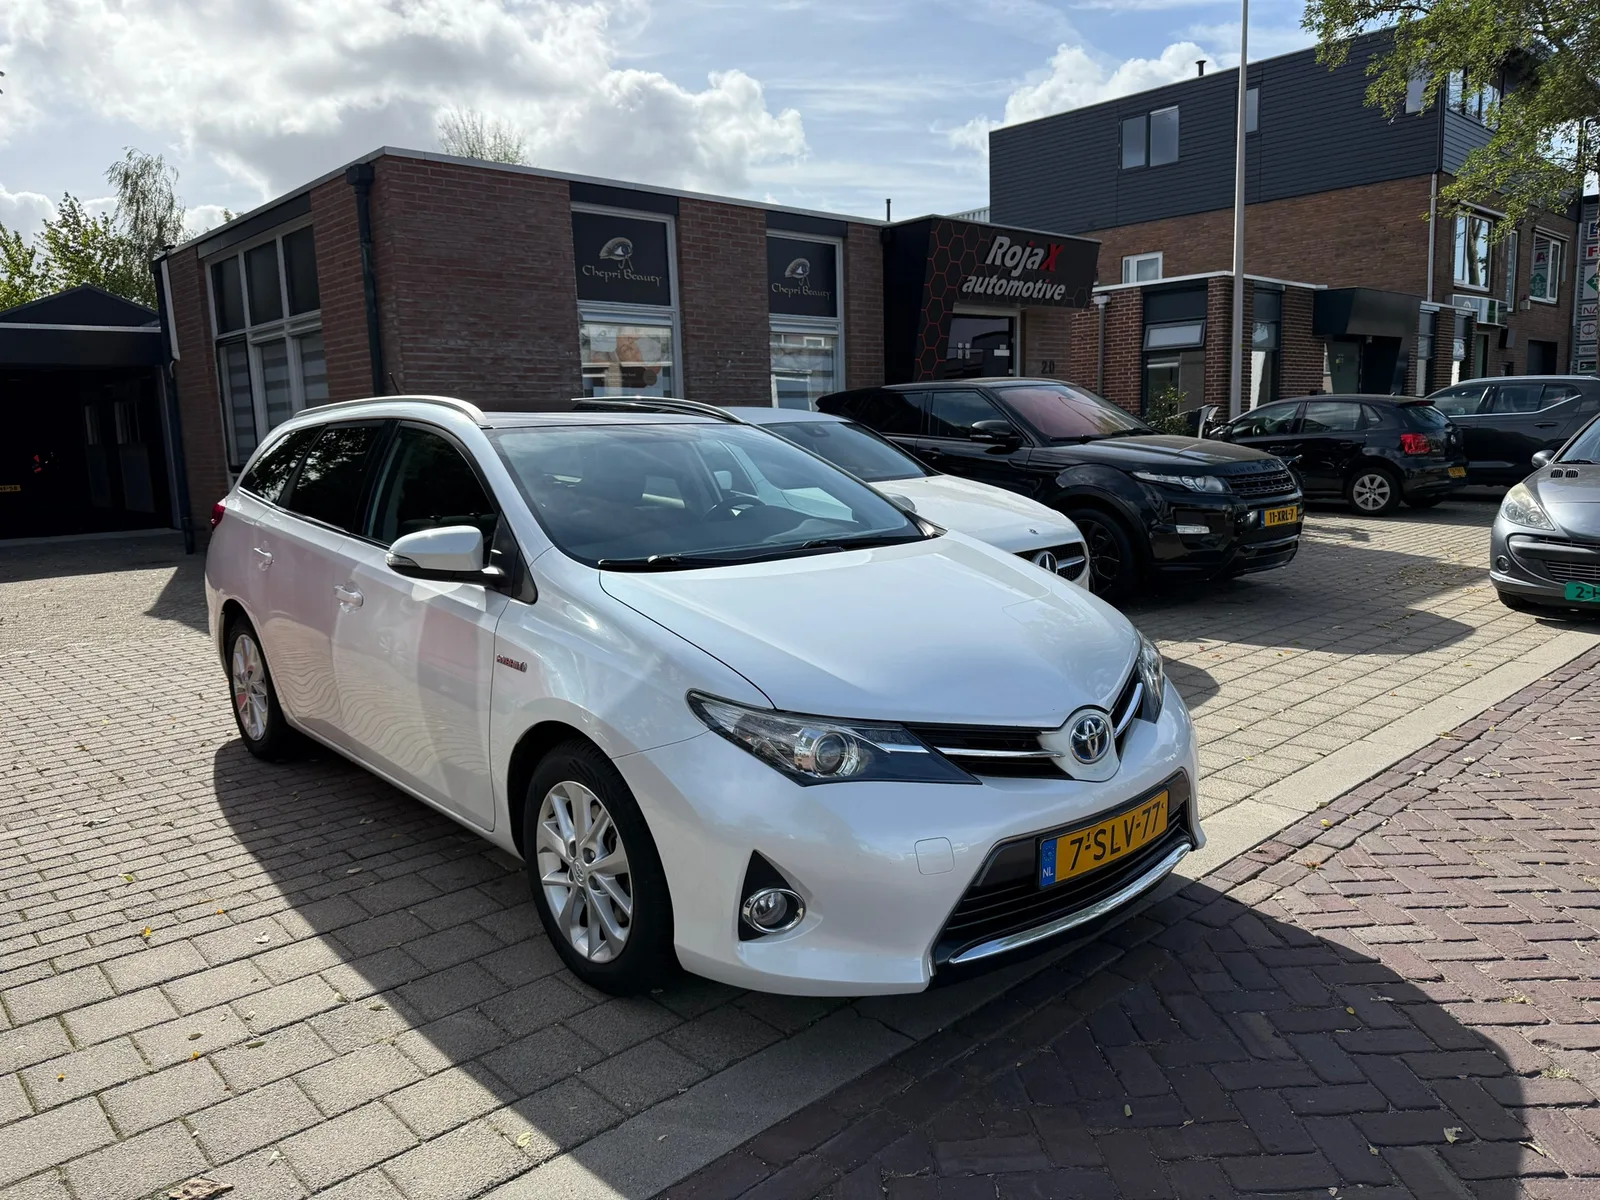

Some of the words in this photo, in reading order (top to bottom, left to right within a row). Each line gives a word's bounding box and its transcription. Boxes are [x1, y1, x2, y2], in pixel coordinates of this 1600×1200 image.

[985, 236, 1064, 277] RojaX
[582, 265, 621, 283] Chepri
[623, 268, 662, 287] Beauty
[771, 282, 801, 298] Chepri
[802, 285, 832, 300] Beauty
[962, 274, 1066, 300] automotive
[1041, 360, 1055, 375] 20
[1269, 508, 1294, 524] 11-XRL-7
[1069, 801, 1161, 872] 7-SLV-77
[1042, 866, 1054, 877] NL
